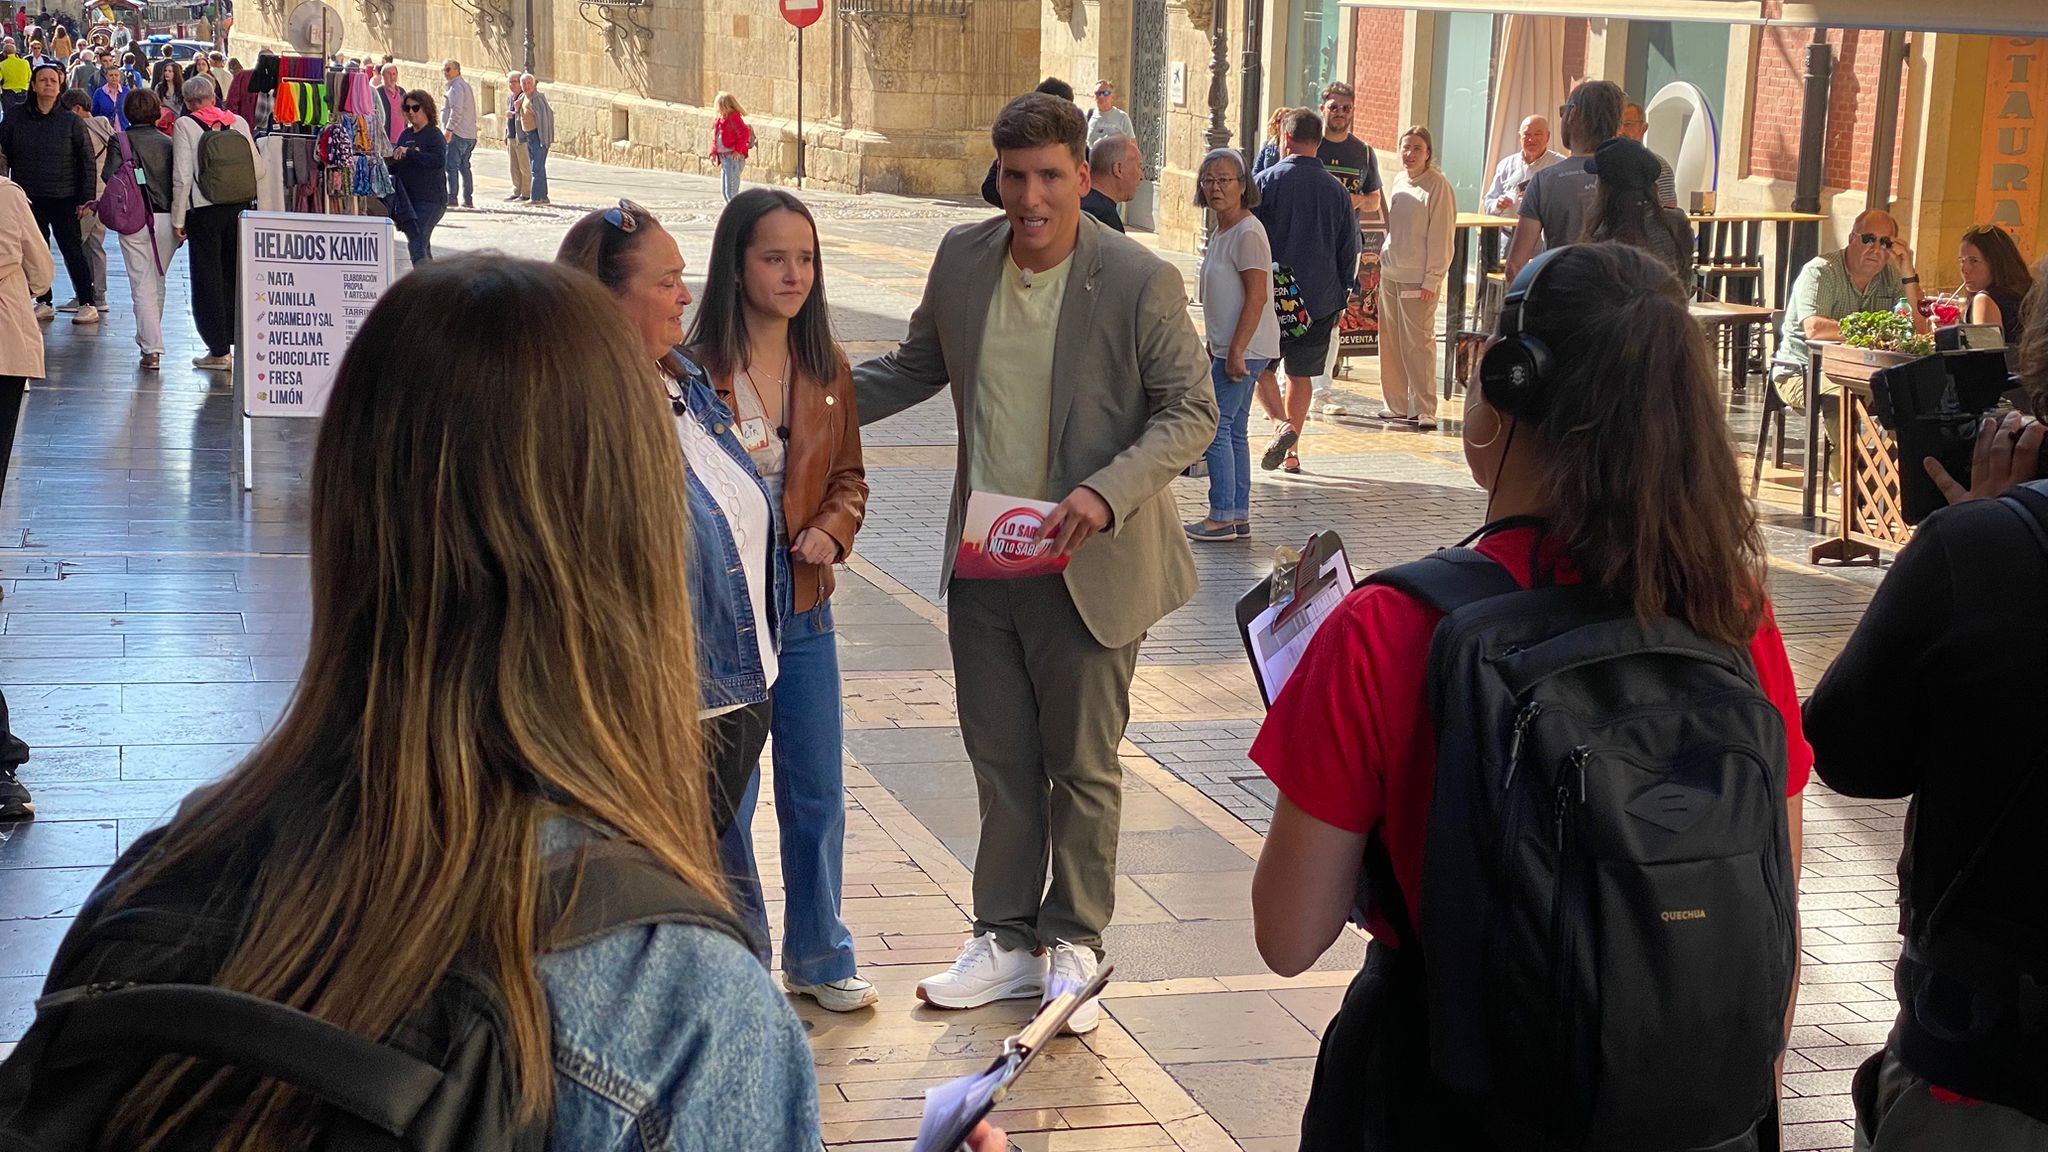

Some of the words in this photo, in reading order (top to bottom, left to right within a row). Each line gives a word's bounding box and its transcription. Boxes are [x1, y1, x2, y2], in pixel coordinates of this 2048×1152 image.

[1990, 36, 2037, 248] TAURA
[254, 231, 326, 261] HELADOS
[329, 232, 379, 262] KAMÍN
[267, 271, 295, 286] NATA
[343, 273, 377, 283] ELABORACIÓN
[343, 282, 364, 291] PROPIA
[267, 291, 316, 307] VAINILLA
[343, 291, 348, 299] Y
[349, 291, 378, 300] ARTESANA
[267, 311, 311, 327] CARAMELO
[311, 313, 318, 327] Y
[318, 313, 334, 327] SAL
[268, 330, 323, 347] AVELLANA
[1340, 335, 1350, 344] DE
[1350, 335, 1374, 344] VENTA
[268, 350, 330, 367] CHOCOLATE
[269, 370, 303, 386] FRESA
[269, 387, 303, 405] LIMÓN
[1002, 522, 1016, 535] LO
[989, 537, 1005, 555] NO
[1005, 541, 1015, 553] LO
[1660, 909, 1706, 922] QUECHUA
